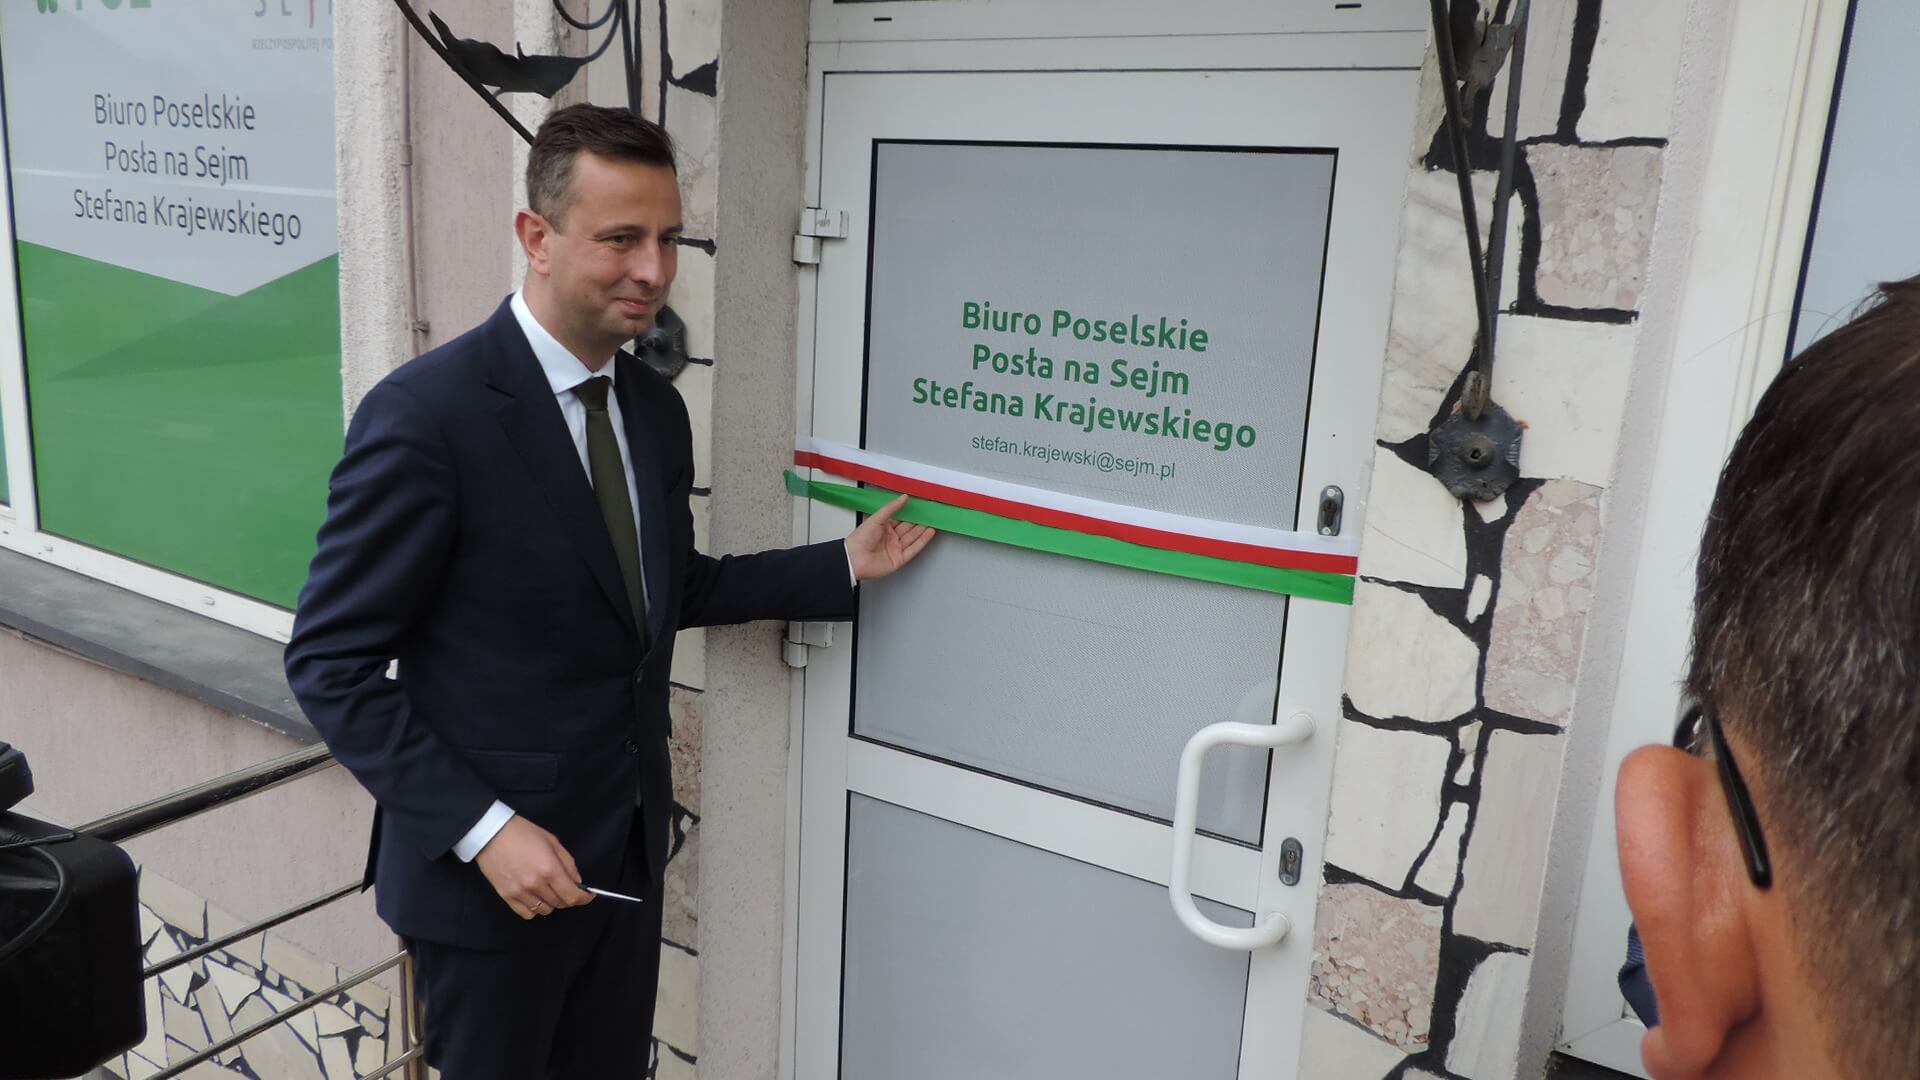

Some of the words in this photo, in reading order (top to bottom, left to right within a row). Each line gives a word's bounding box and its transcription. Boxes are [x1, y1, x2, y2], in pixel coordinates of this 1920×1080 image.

[94, 93, 147, 126] Biuro
[153, 93, 256, 131] Poselskie
[104, 140, 158, 175] Posła
[164, 151, 189, 177] na
[194, 145, 249, 186] Sejm
[73, 188, 148, 225] Stefana
[153, 195, 302, 246] Krajewskiego
[962, 300, 1042, 336] Biuro
[1052, 309, 1209, 353] Poselskie
[972, 343, 1054, 380] Posła
[1063, 359, 1100, 386] na
[1109, 358, 1190, 398] Sejm
[911, 377, 1024, 418] Stefana
[1033, 392, 1257, 453] Krajewskiego
[971, 434, 1176, 482] stefan.krajewski@sejm.pl
